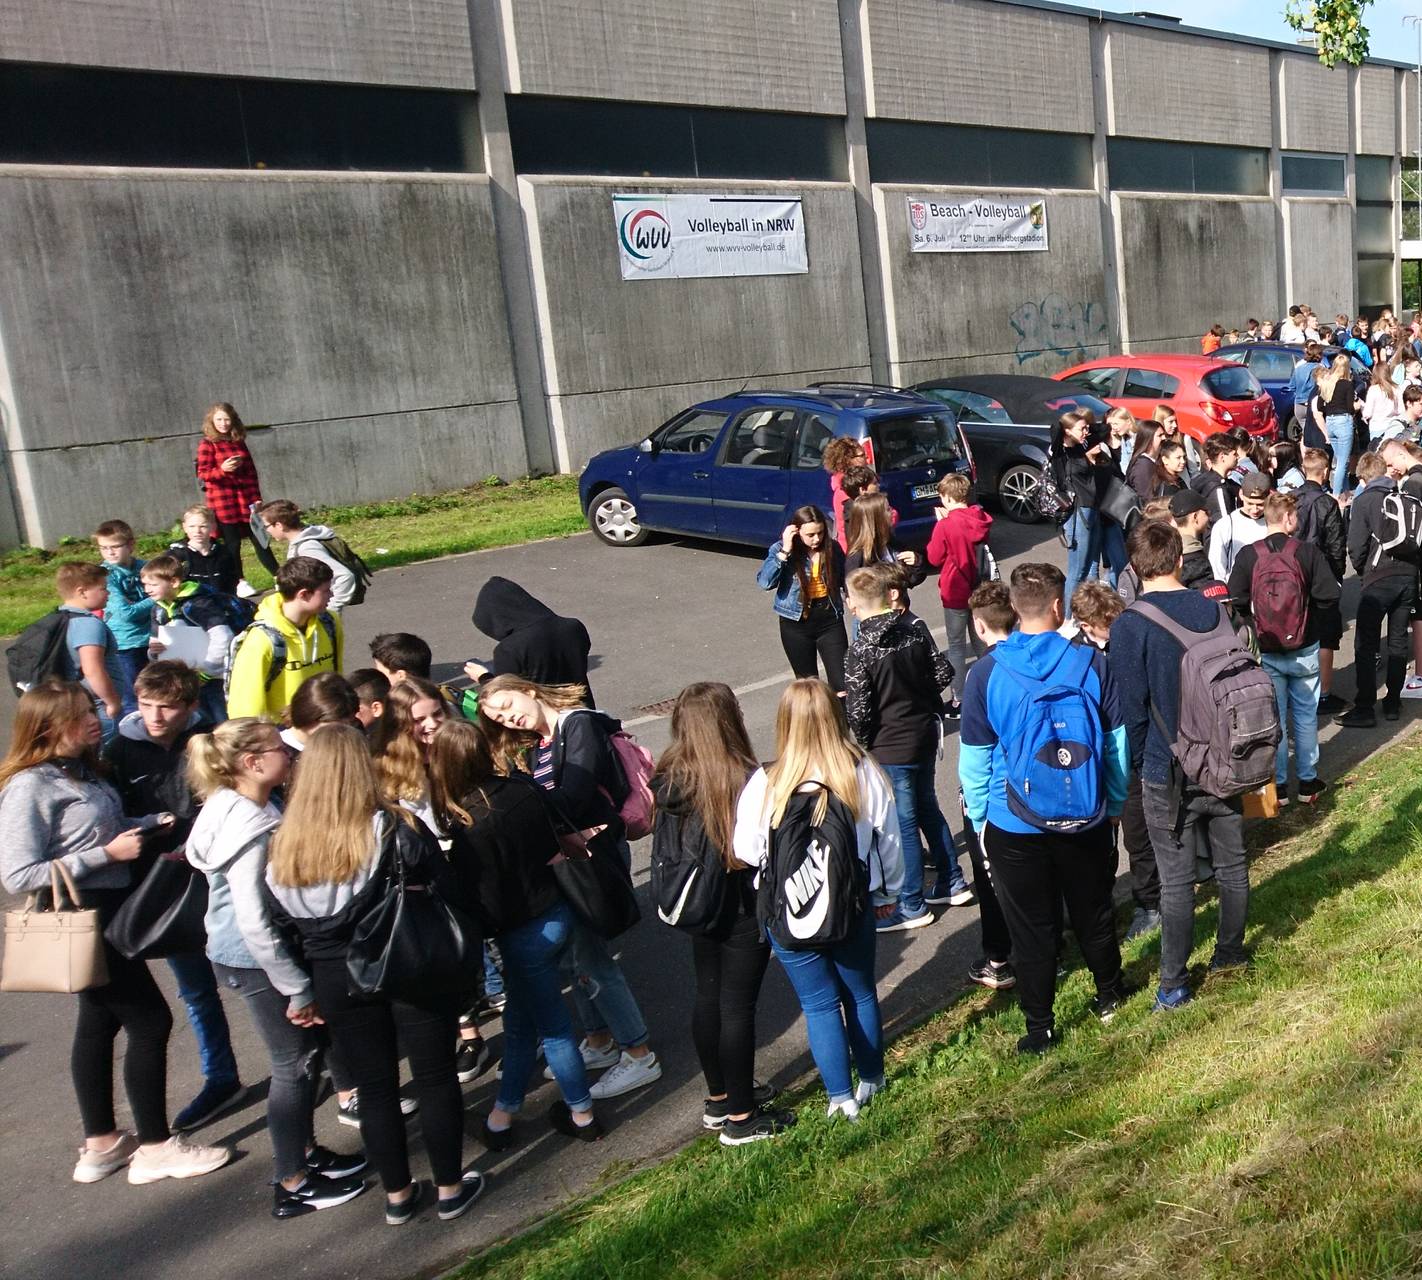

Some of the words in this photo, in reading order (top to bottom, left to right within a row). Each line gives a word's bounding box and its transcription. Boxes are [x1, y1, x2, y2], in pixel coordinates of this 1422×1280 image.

[930, 203, 966, 217] Beach
[974, 204, 1026, 220] Volleyball
[688, 216, 749, 235] Volleyball
[752, 218, 764, 232] in
[767, 218, 795, 232] NRW
[973, 234, 985, 242] Uhr
[705, 243, 786, 254] www.wvv-volleyball.de
[785, 840, 825, 915] NIKE
